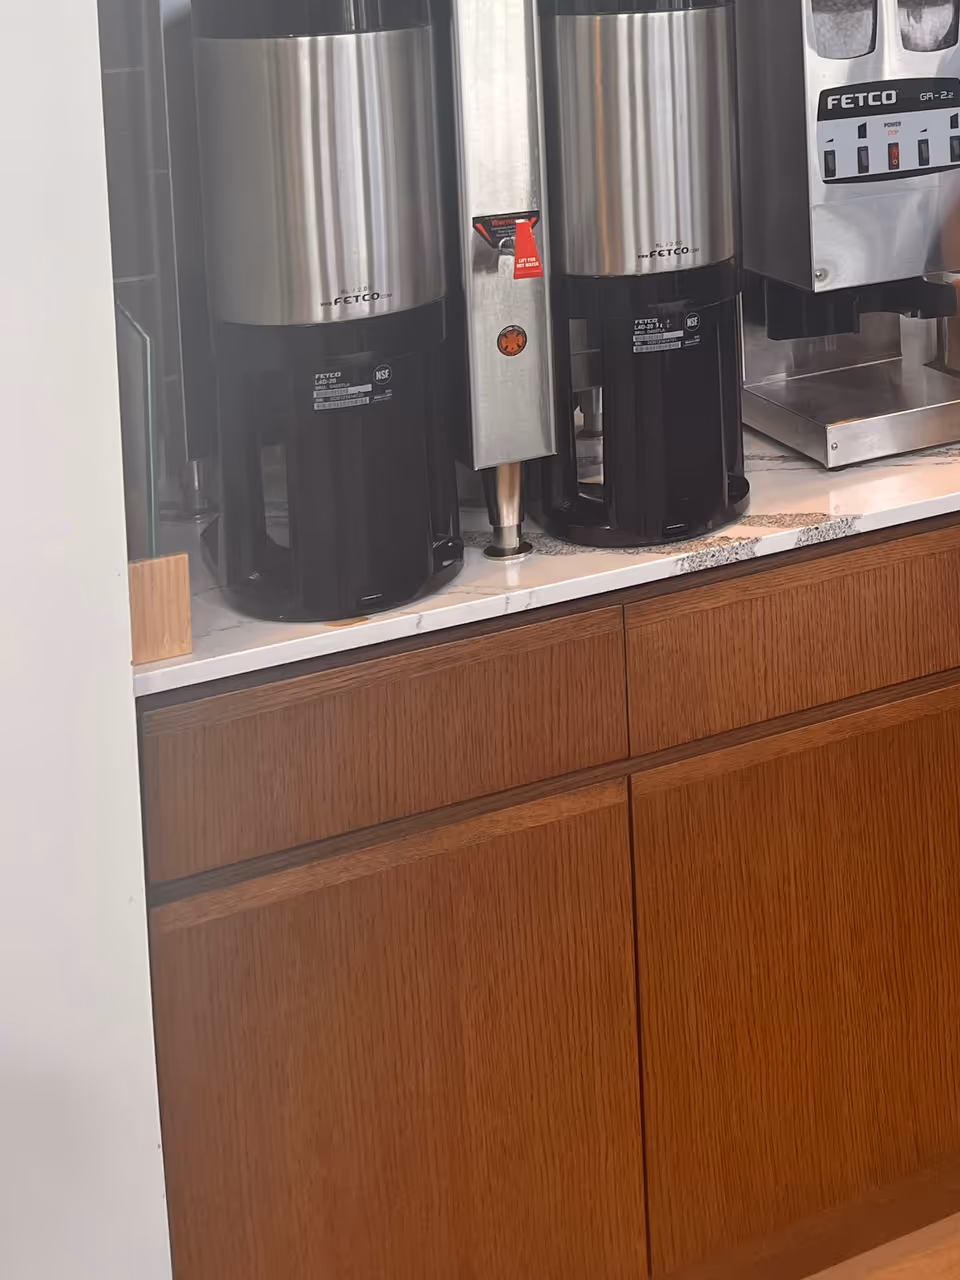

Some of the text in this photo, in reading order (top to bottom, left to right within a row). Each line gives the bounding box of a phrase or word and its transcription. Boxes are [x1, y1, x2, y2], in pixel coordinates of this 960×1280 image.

[827, 90, 897, 109] FETCO
[687, 316, 698, 328] NSF
[315, 368, 390, 380] FETCO NSF
